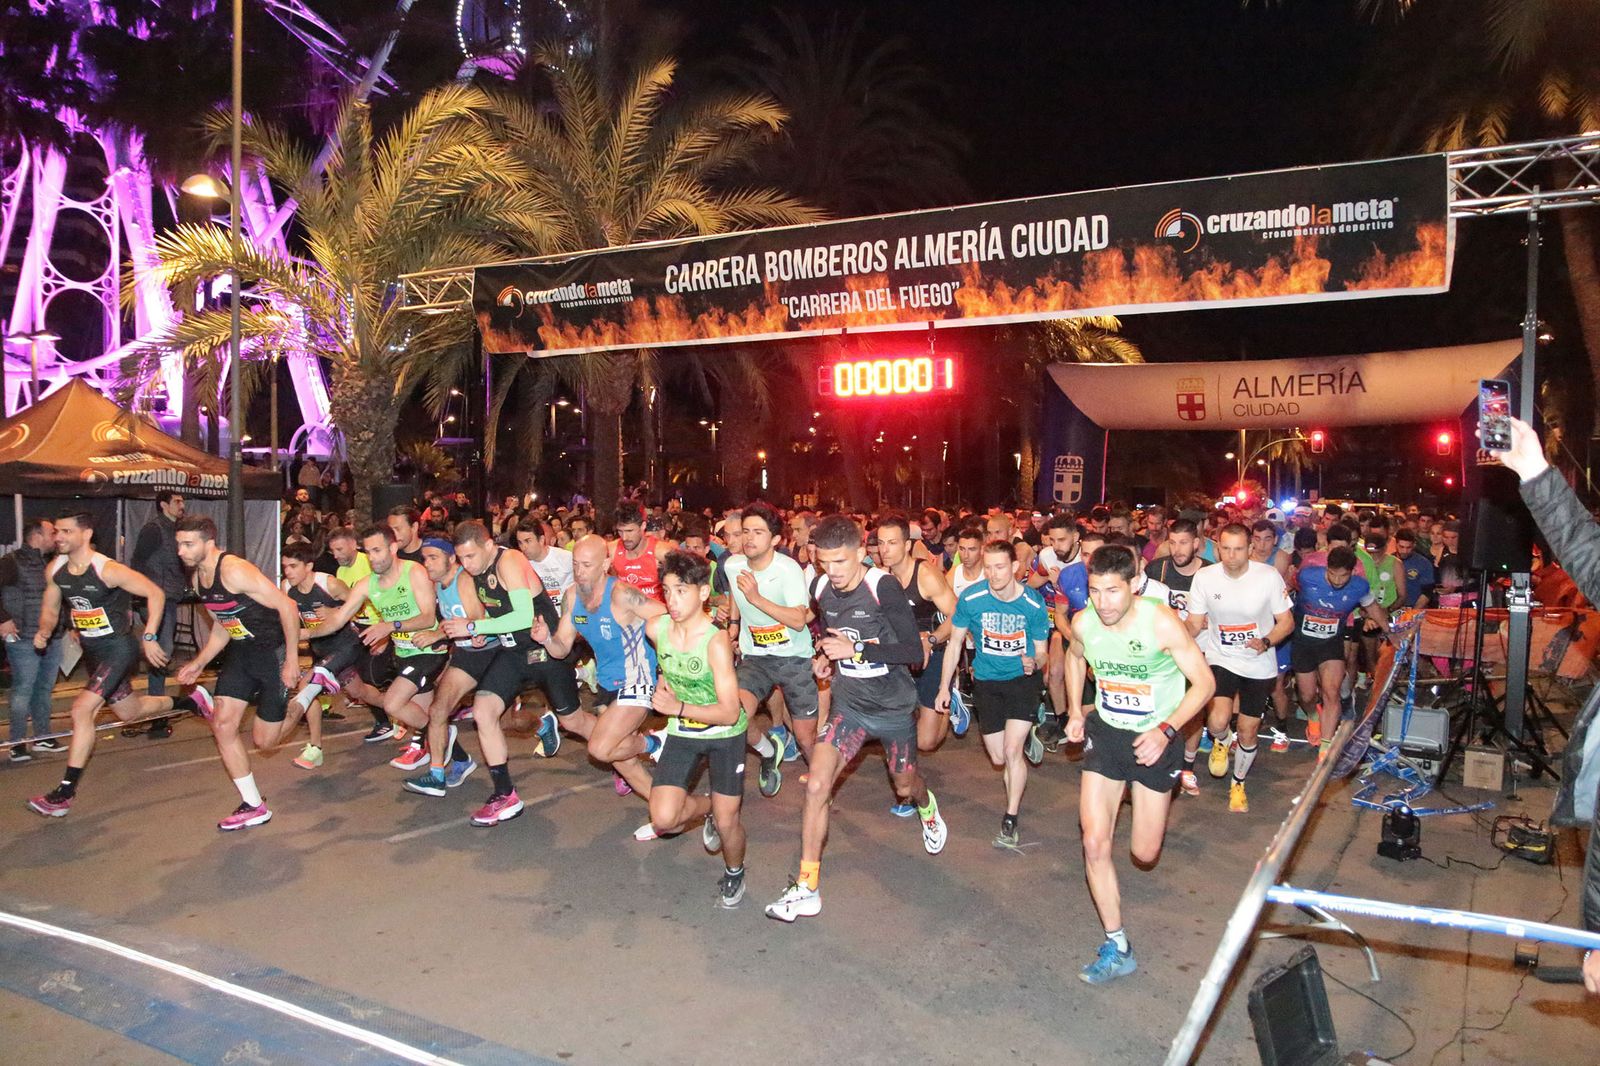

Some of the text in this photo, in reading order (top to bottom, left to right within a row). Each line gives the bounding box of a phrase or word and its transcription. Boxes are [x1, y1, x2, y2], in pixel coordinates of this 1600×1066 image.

[1262, 220, 1394, 240] cronometraje deportivo
[665, 214, 1109, 295] CARRERA BOMBEROS ALMERÍA CIUDAD
[602, 295, 634, 305] deportivo
[865, 288, 897, 312] DEL
[1233, 367, 1367, 399] ALMERÍA
[1233, 402, 1300, 418] CIUDAD
[112, 467, 229, 489] cruzandolamet
[1312, 622, 1333, 632] 281
[757, 632, 783, 642] 2659
[1229, 631, 1255, 641] 295
[994, 640, 1021, 649] 183
[1094, 659, 1148, 673] Universo
[1114, 694, 1141, 707] 513
